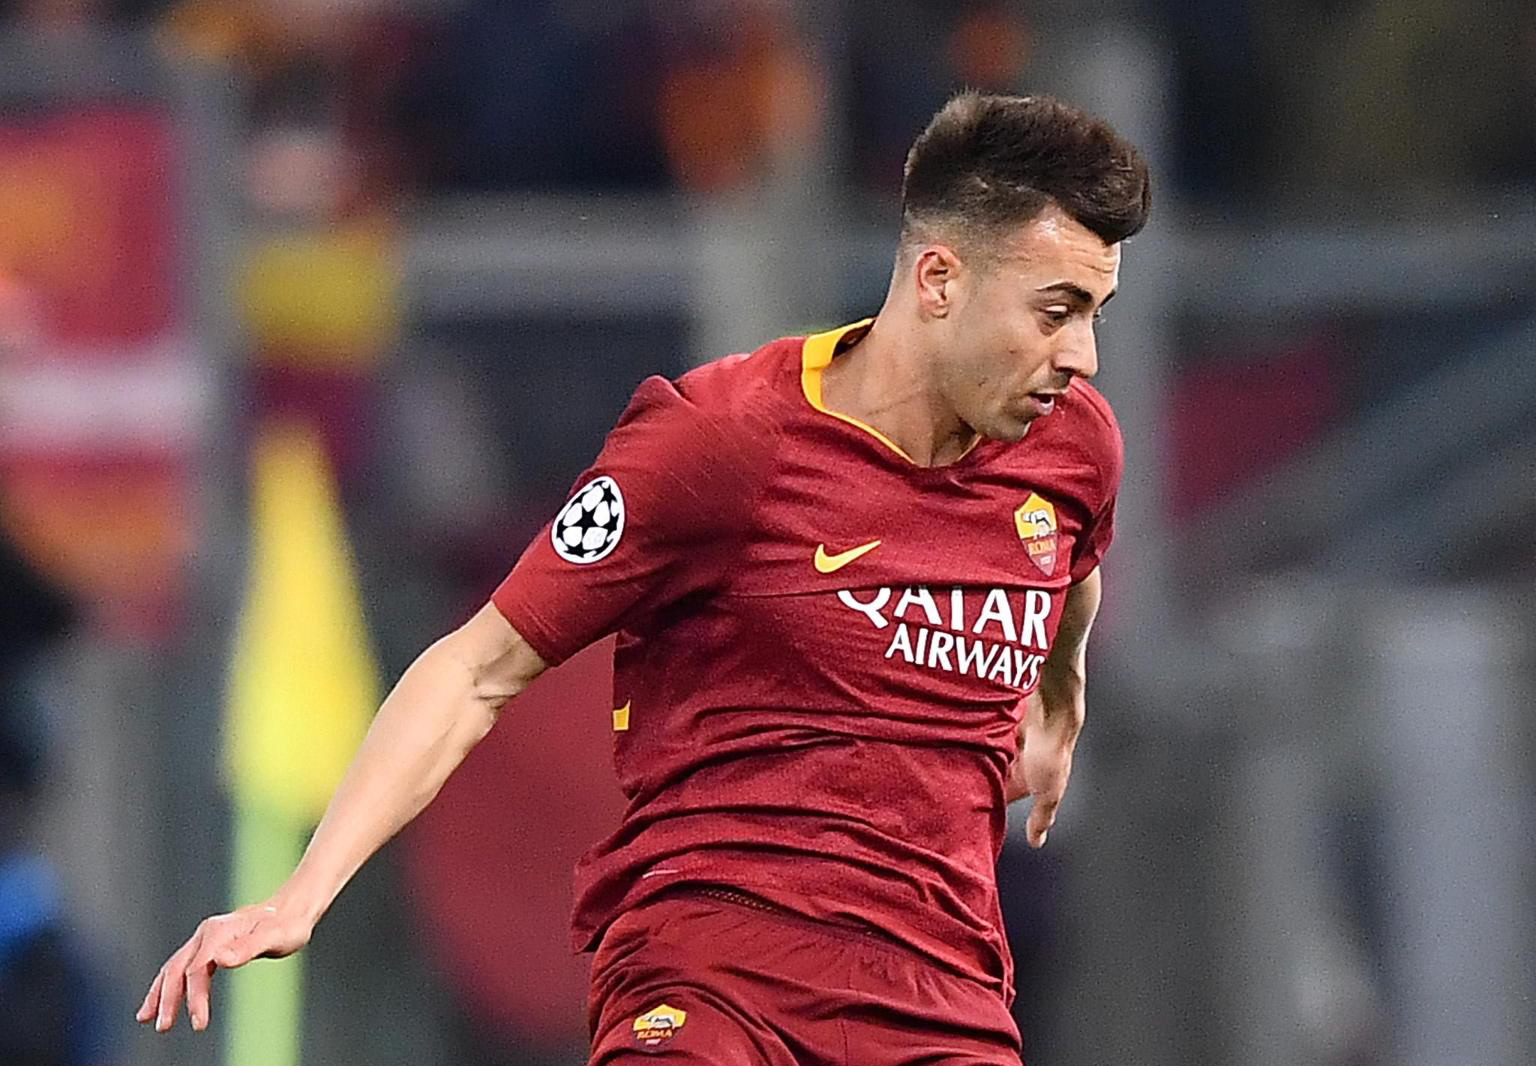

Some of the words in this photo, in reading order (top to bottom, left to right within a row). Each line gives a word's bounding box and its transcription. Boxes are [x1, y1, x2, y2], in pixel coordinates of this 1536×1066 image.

[837, 586, 1052, 650] QATAR
[884, 622, 1046, 690] AIRWAYS
[636, 1029, 674, 1041] ROMA
